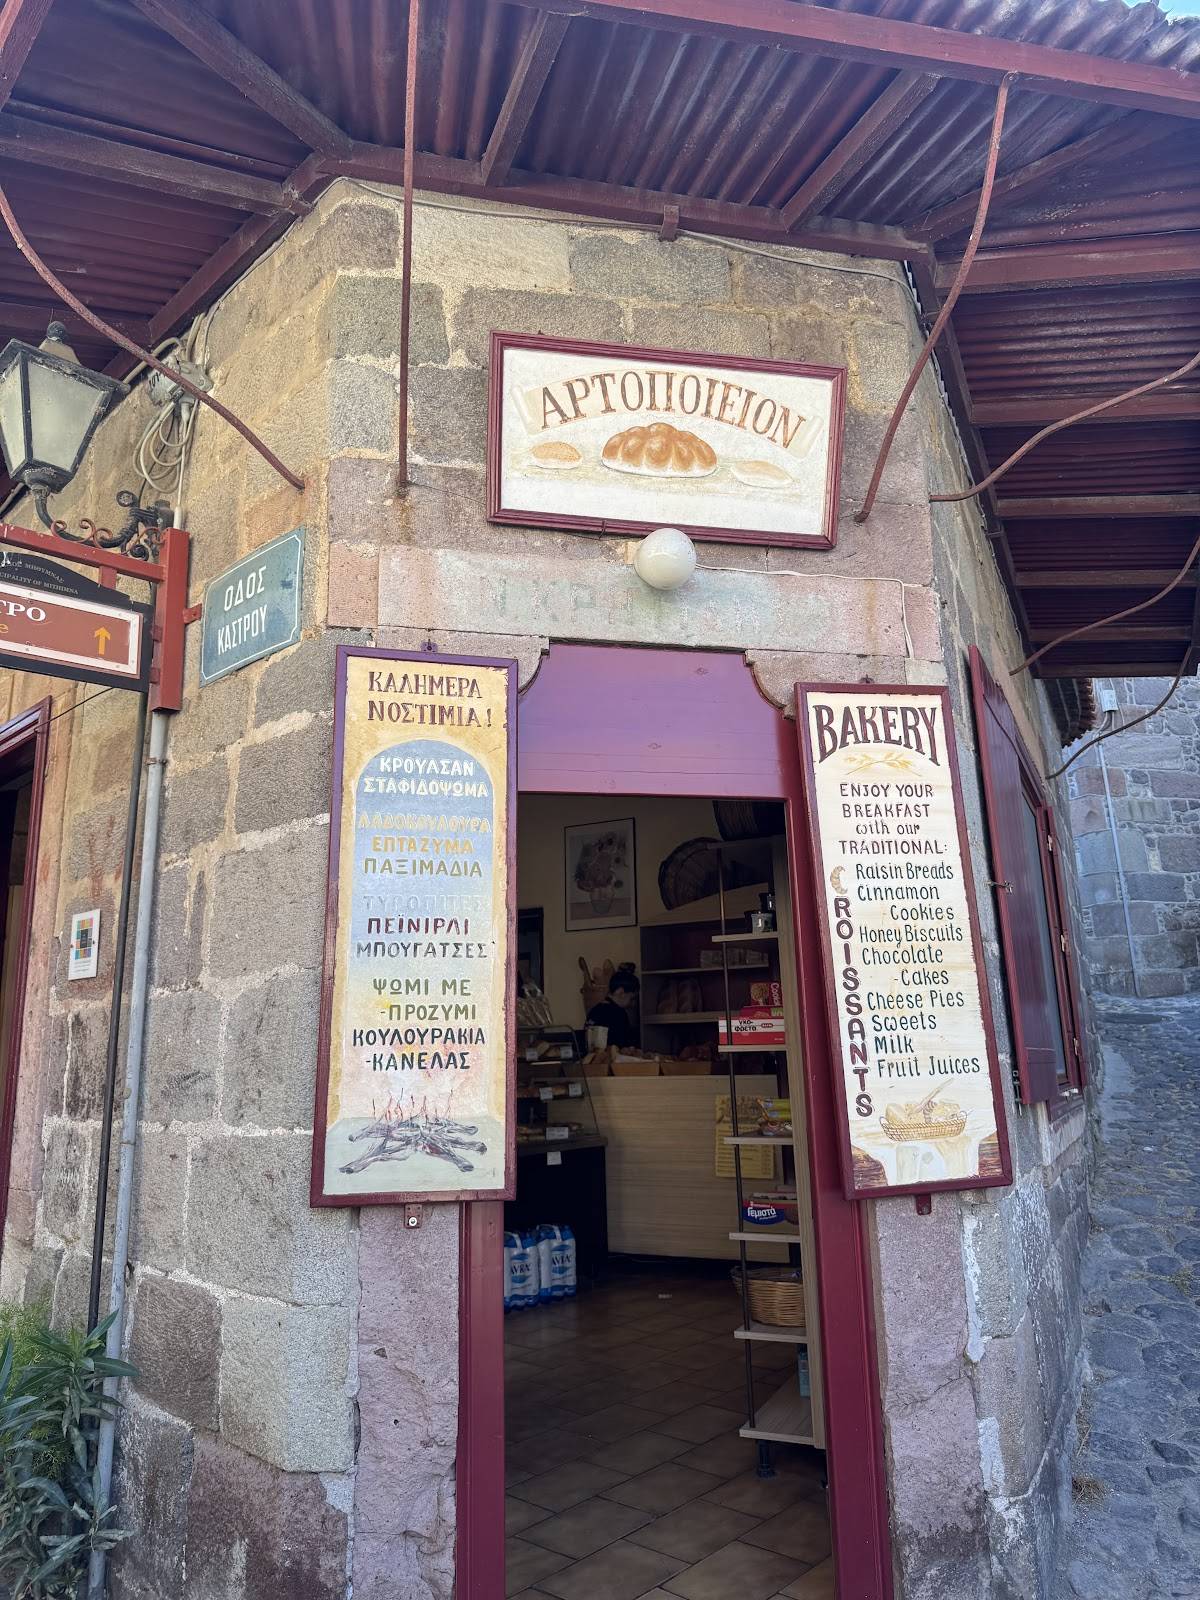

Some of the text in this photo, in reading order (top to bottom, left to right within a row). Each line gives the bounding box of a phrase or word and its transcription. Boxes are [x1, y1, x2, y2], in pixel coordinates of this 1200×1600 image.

[540, 370, 807, 450] ΑΡΤΟΠΟΙΕΙΟΝ
[224, 565, 267, 612] ΟΔΟΣ
[217, 604, 268, 656] ΚΑΣΤΡΟΥ
[368, 671, 483, 699] ΚΑΛΗΜΕΡΑ
[812, 704, 940, 766] BAKERY
[379, 756, 475, 777] ΚΡΟΥΑΣΑΝ
[363, 776, 488, 798] ΣΤΑΦΙΔΟΨΩΜΑ
[840, 783, 934, 798] ENJOY YOUR
[842, 803, 930, 818] BREAKFAST
[856, 819, 921, 835] with our
[371, 836, 475, 855] ΕΠΤΑΖΥΜΑ
[839, 839, 948, 855] TRADITIONAL:
[364, 857, 482, 878] ΠΑΞΙΜΑΔΙΑ
[855, 861, 954, 881] Raisin Breads
[857, 885, 940, 902] Cinnamon
[890, 904, 955, 922] Cookies
[859, 923, 963, 948] Honey Biscuits
[356, 941, 488, 959] ΜΠΟΥΓΑΤΣΕΣ
[862, 947, 943, 965] Chocolate
[373, 978, 471, 996] ΨΩΜΙ ΜΕ
[867, 989, 964, 1010] Cheese Pies
[871, 1013, 937, 1032] Sweets
[353, 1027, 485, 1047] ΚΟΥΛΟΥΡΑΚΙΑ
[874, 1035, 914, 1054] Milk
[877, 1055, 980, 1078] Fruit Juices
